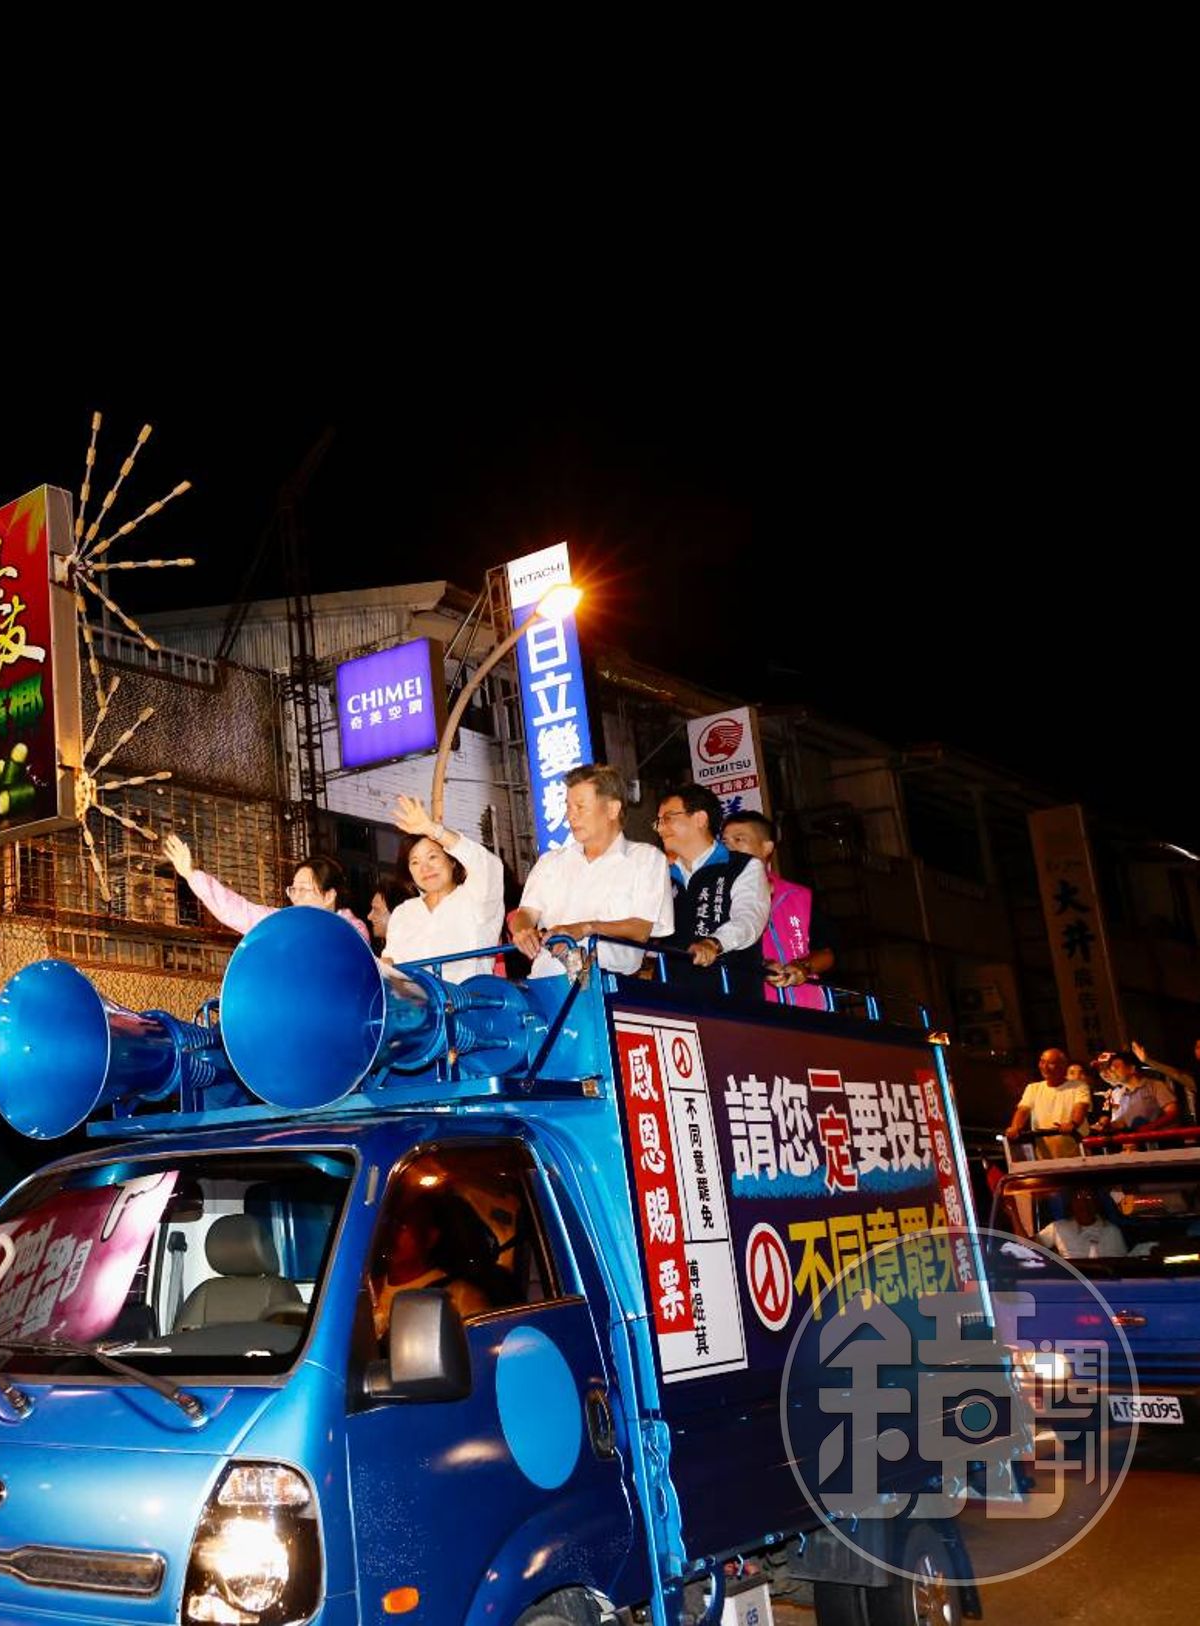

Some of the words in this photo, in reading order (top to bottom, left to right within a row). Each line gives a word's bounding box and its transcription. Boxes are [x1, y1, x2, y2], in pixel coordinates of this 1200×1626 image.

[513, 563, 565, 588] HITACHI
[347, 676, 422, 714] CHIMEI
[526, 618, 583, 851] 日立變
[699, 760, 751, 778] IDEMITSU
[628, 1043, 685, 1321] 感恩賜票
[683, 1097, 715, 1229] 不同意罷免
[923, 1079, 972, 1283] 感恩賜票
